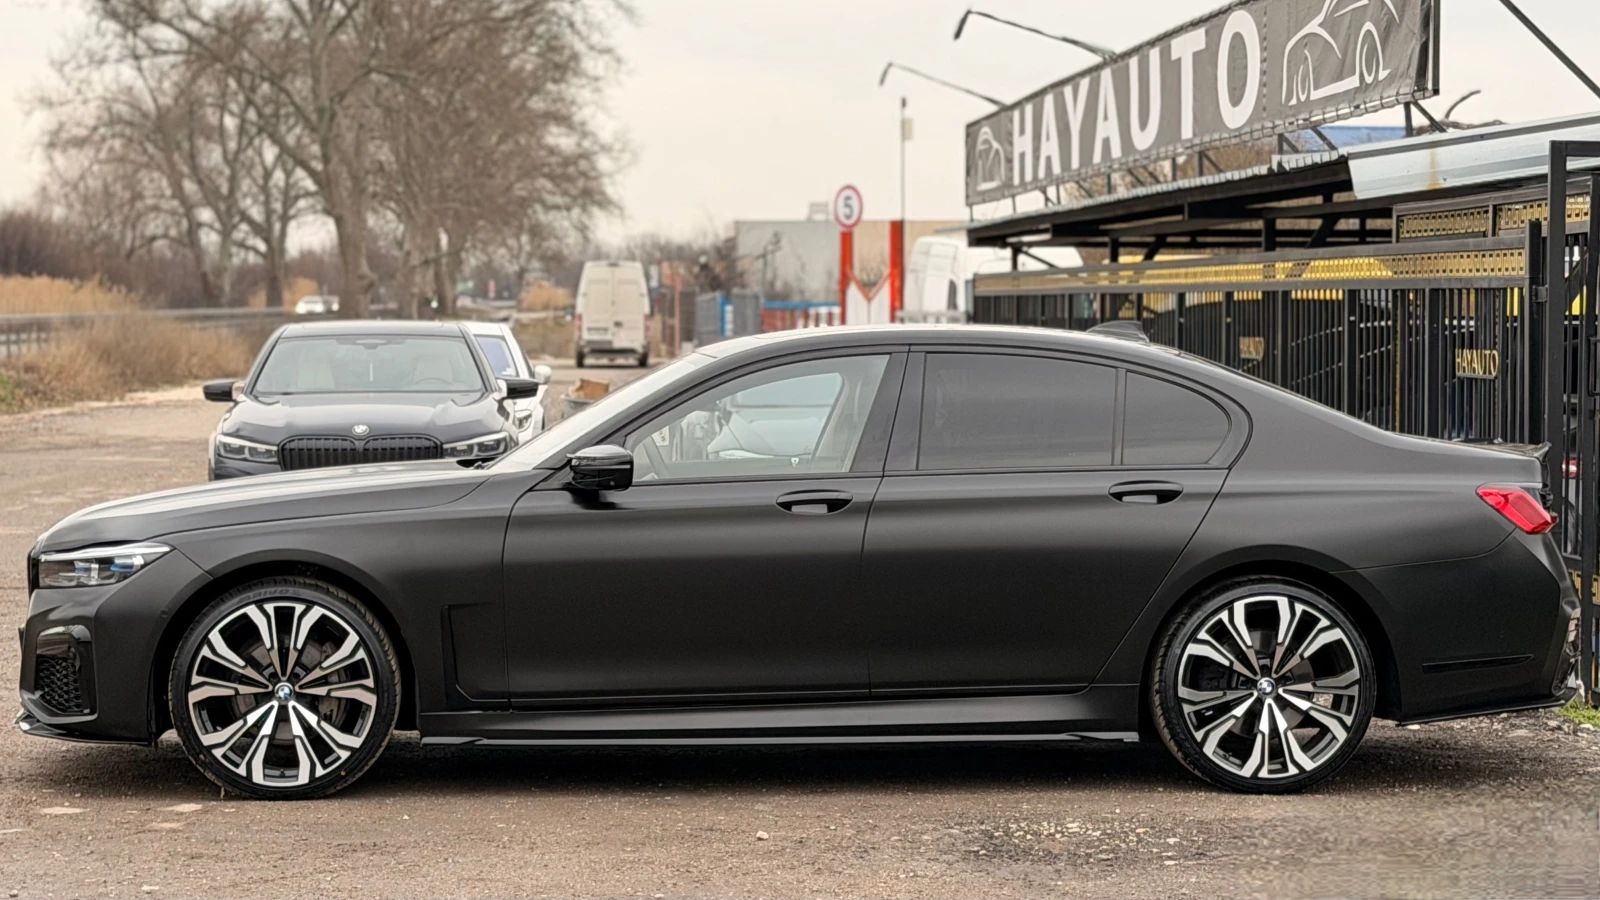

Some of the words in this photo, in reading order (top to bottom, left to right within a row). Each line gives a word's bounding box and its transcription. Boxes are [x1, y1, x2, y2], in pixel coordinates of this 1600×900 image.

[1013, 10, 1261, 185] HAYAUTO
[843, 196, 853, 220] 5
[1455, 349, 1498, 376] HAYAUTO
